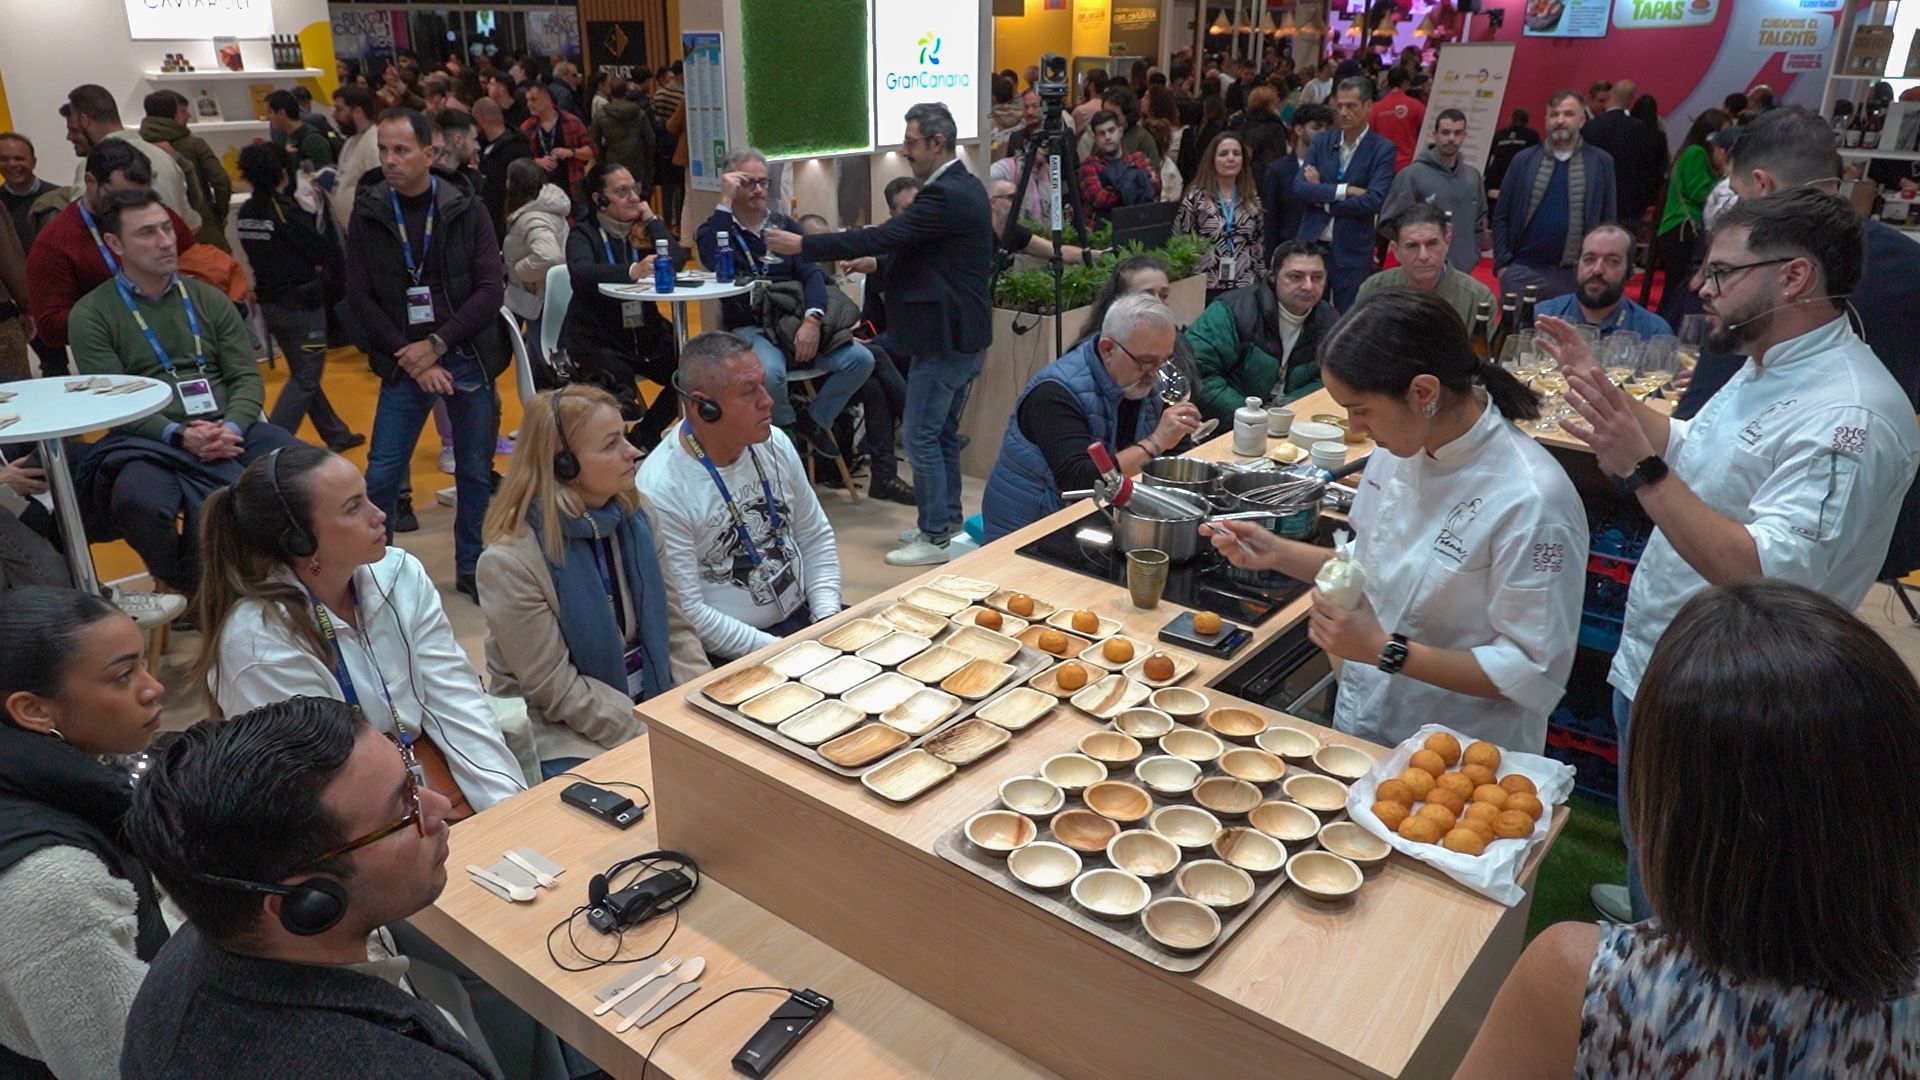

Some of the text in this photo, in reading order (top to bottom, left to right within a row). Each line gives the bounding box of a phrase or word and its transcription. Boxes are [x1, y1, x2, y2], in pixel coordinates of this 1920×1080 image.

[1633, 0, 1685, 20] TAPAS
[1758, 30, 1818, 46] TALENTO
[886, 71, 970, 90] GranCanaria
[687, 434, 705, 458] makro
[315, 604, 336, 639] makro
